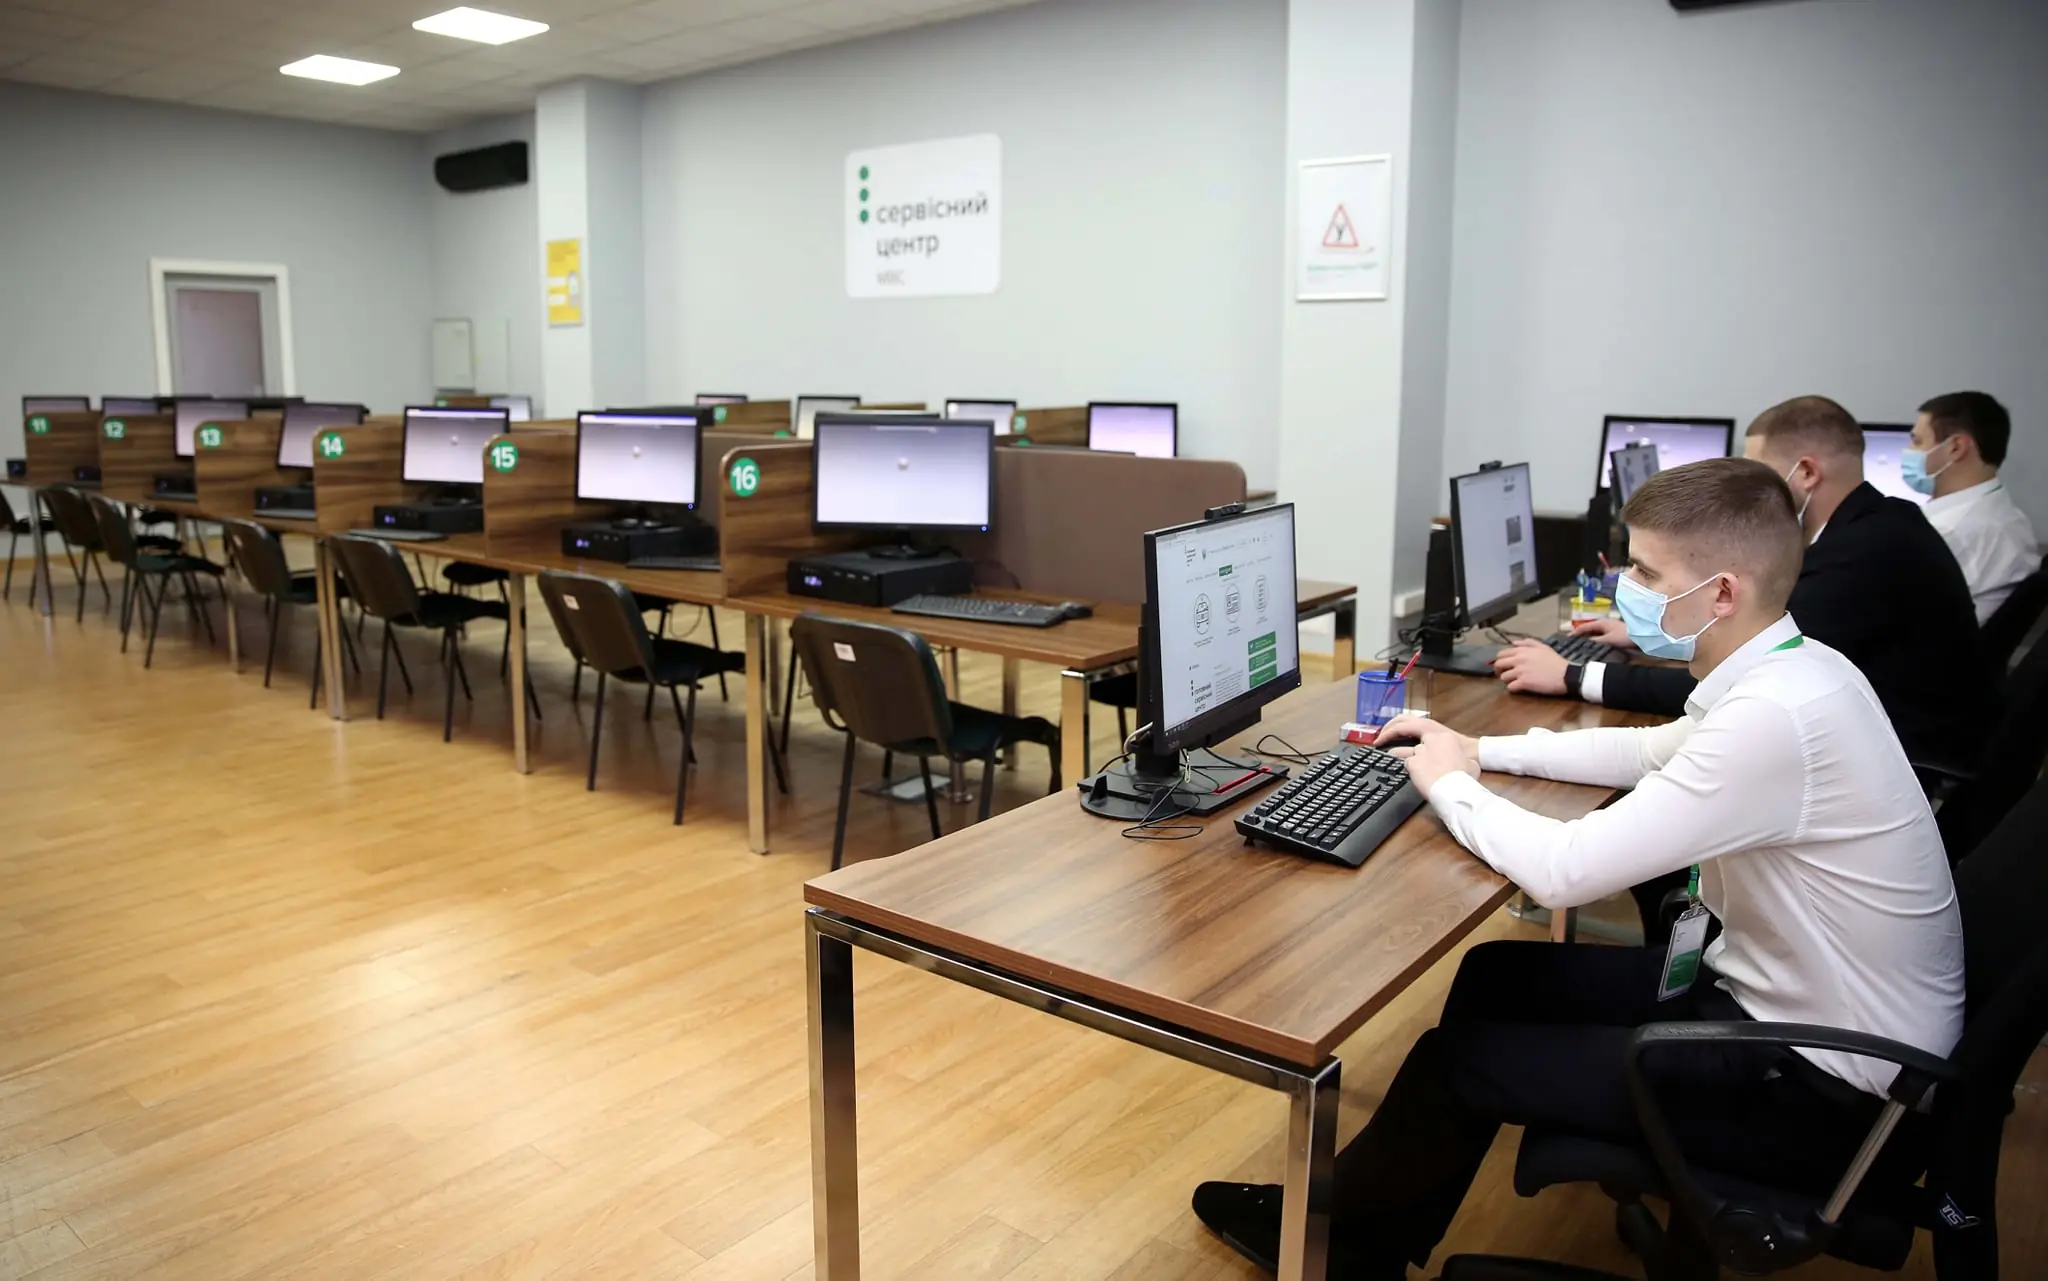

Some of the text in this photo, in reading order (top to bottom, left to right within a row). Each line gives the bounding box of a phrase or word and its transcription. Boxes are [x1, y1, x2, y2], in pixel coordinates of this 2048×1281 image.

[876, 191, 989, 228] сервісний
[876, 234, 940, 260] центр
[32, 418, 47, 433] 11
[104, 421, 124, 438] 12
[200, 428, 222, 447] 13
[320, 436, 344, 457] 14
[491, 446, 516, 469] 15
[731, 465, 757, 490] 16
